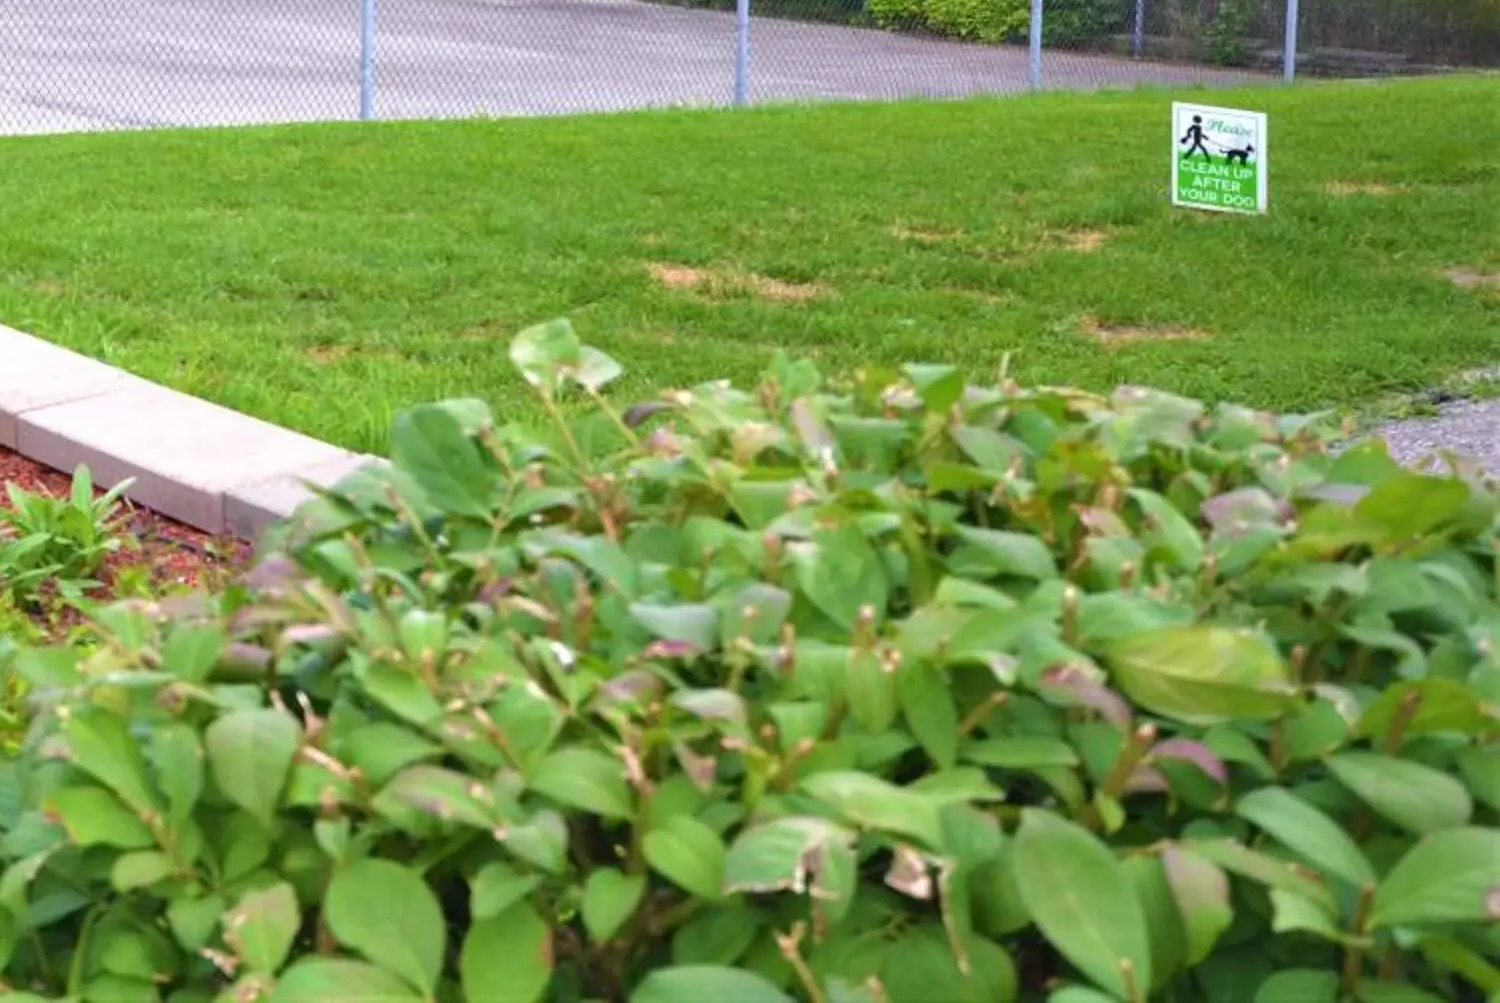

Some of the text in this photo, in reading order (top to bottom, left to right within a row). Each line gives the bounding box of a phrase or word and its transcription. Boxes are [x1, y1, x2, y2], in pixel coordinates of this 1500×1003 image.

[1180, 160, 1253, 180] CLEAN UP
[1192, 175, 1241, 191] AFTER
[1179, 186, 1255, 207] YOUR DOG
